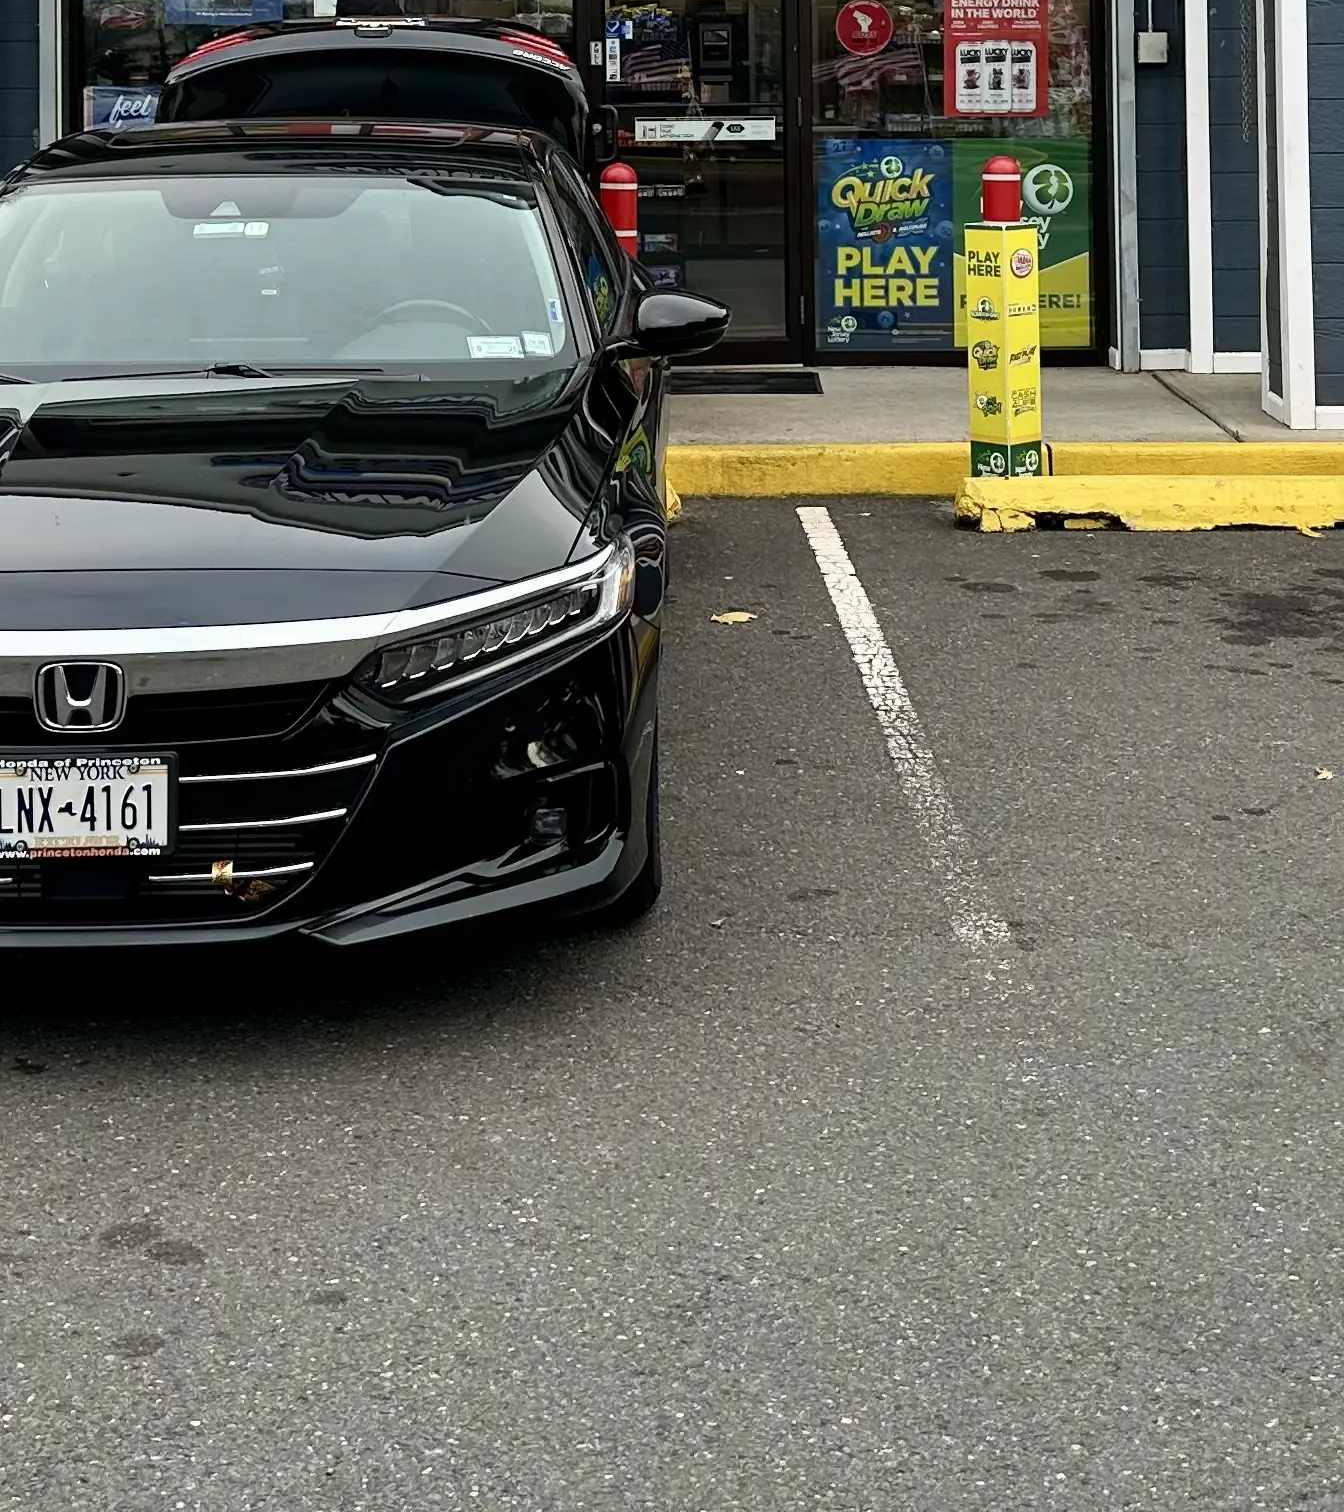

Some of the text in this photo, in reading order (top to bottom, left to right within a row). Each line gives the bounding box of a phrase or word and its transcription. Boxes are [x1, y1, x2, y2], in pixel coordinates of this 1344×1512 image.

[951, 9, 964, 18] IN
[966, 9, 990, 18] THE
[109, 94, 152, 124] feel
[832, 168, 935, 217] Quick
[854, 198, 931, 227] Draw
[837, 246, 939, 274] PLAY
[967, 264, 1001, 277] HERE
[968, 251, 1000, 264] PLAY
[834, 278, 939, 306] HERE
[30, 765, 125, 781] NEW YORK
[54, 758, 71, 767] of
[76, 757, 161, 767] Princeton
[80, 784, 153, 832] 4161
